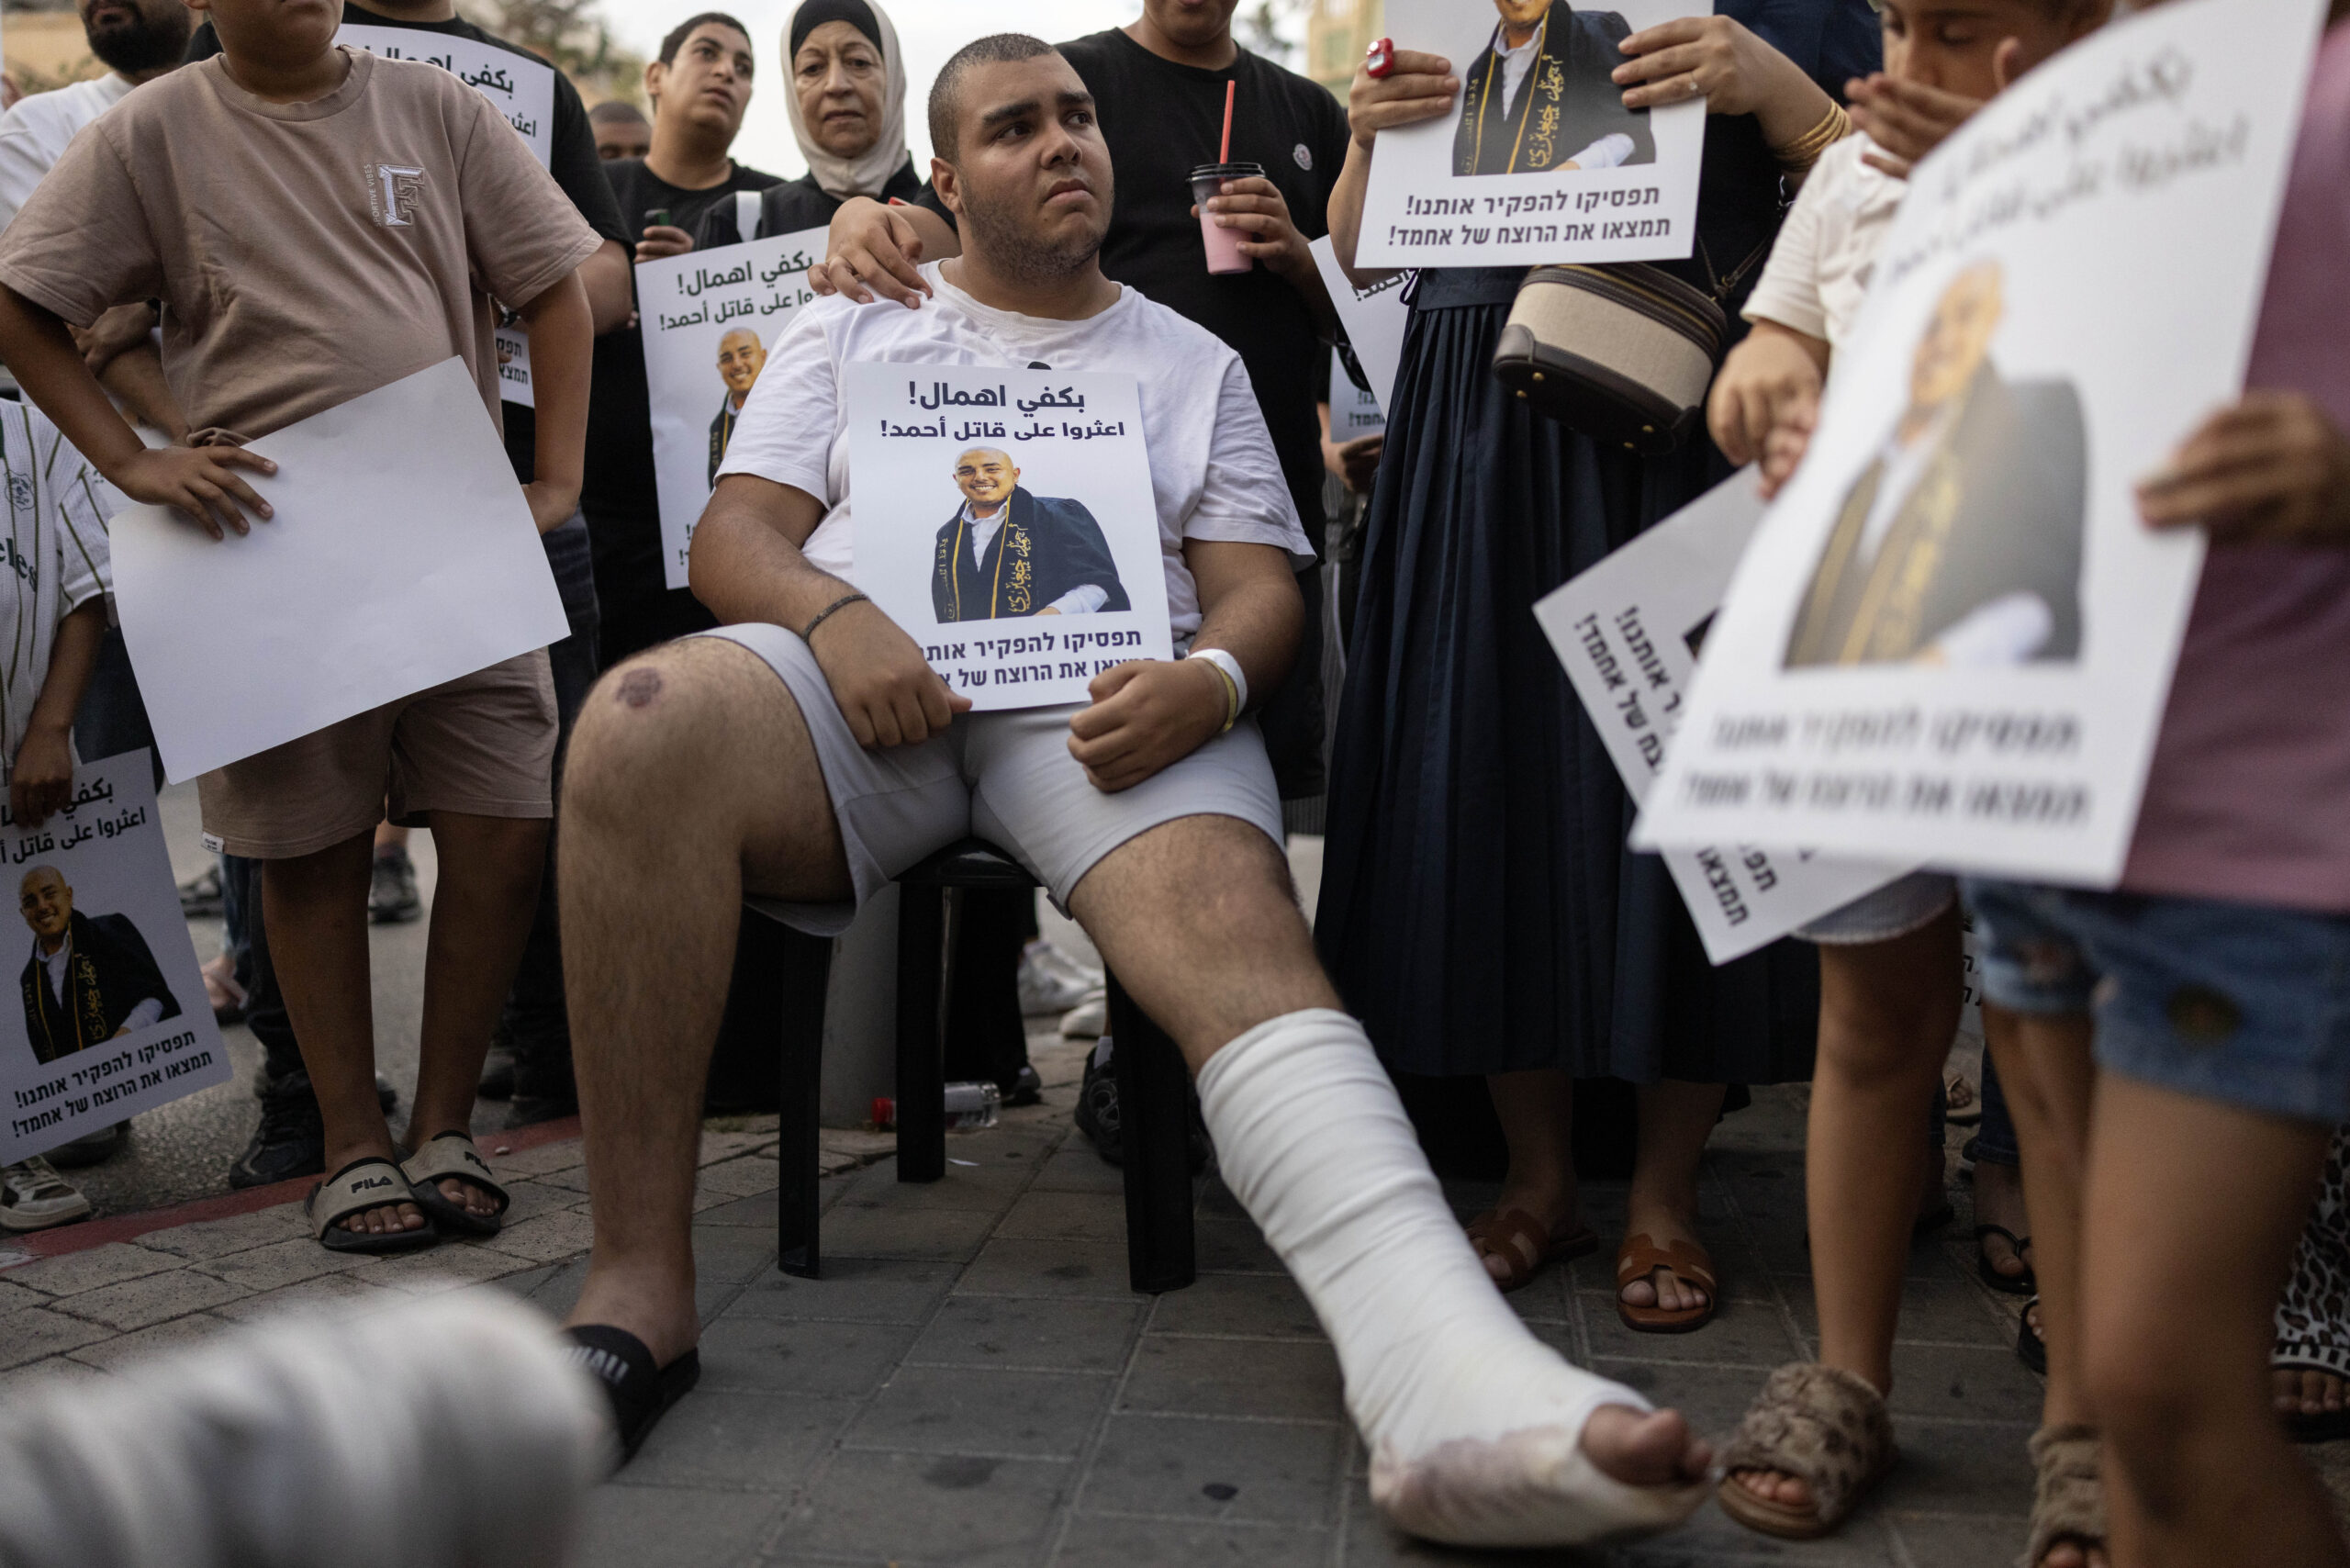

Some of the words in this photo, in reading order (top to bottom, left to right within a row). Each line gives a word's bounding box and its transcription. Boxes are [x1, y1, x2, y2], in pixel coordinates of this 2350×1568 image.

[364, 163, 375, 187] VIBES
[369, 188, 382, 227] SPORTIVE
[1405, 195, 1475, 216] אותנו!
[1483, 190, 1568, 218] להפקיר
[1575, 186, 1660, 214] תפסיקו
[1388, 225, 1453, 246] אחמד!
[1460, 224, 1490, 245] של
[1496, 225, 1558, 244] הרוצח
[1563, 222, 1595, 241] את
[1602, 218, 1671, 240] תמצאו
[677, 260, 753, 297] اهمال!
[660, 300, 709, 331] أحمد!
[713, 297, 755, 324] قاتل
[760, 293, 792, 316] على
[498, 364, 529, 385] תמצא
[909, 381, 1006, 410] اهمال!
[1016, 386, 1085, 418] بكفي
[880, 416, 946, 438] أحمد!
[954, 421, 1006, 442] قاتل
[1013, 422, 1055, 442] على
[1062, 420, 1125, 440] اعثروا
[974, 632, 1055, 660] להפקיר
[1064, 630, 1142, 653] תפסיקו
[1573, 611, 1628, 692] אחמד!
[1614, 604, 1671, 689] אותנו!
[958, 668, 987, 688] של
[994, 664, 1053, 685] הרוצח
[1059, 661, 1088, 678] את
[1617, 689, 1650, 730] של
[97, 806, 146, 838] اعثروا
[13, 832, 55, 864] قاتل
[61, 823, 94, 850] على
[138, 1030, 196, 1063] תפסיקו
[72, 1049, 133, 1086] להפקיר
[165, 1051, 213, 1080] תמצאו
[15, 1078, 68, 1108] אותנו!
[93, 1079, 138, 1108] הרוצח
[140, 1070, 162, 1090] את
[64, 1096, 88, 1117] של
[12, 1107, 63, 1138] אחמד!
[351, 1176, 394, 1193] FILA
